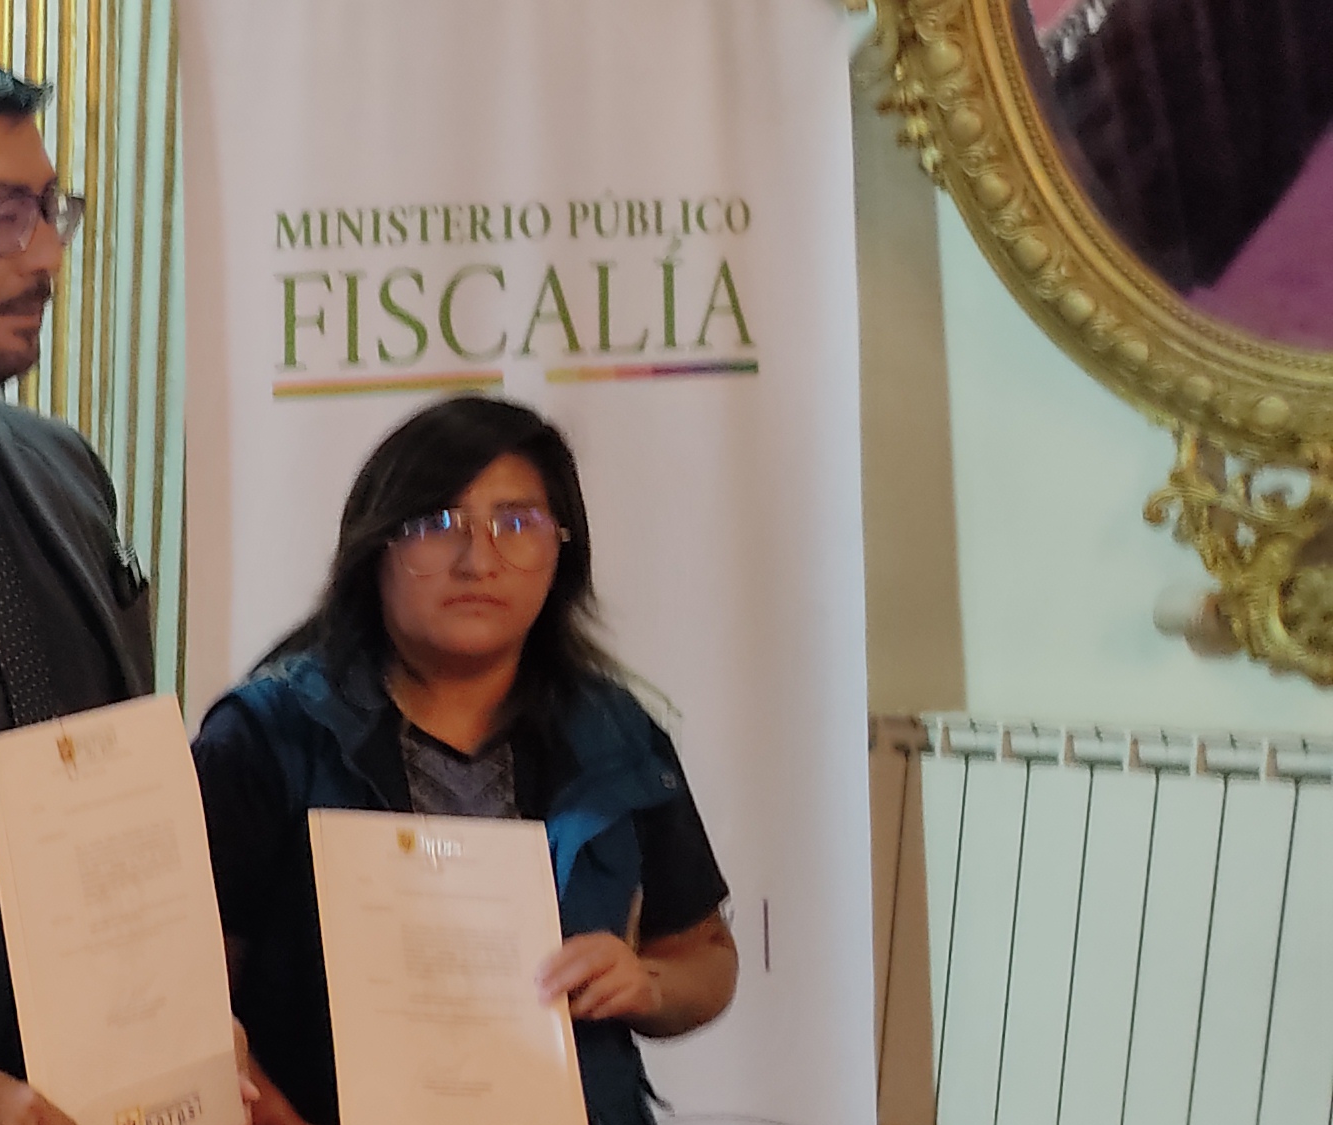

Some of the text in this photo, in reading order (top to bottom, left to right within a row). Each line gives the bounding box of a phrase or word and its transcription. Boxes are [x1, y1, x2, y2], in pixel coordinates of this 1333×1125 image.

[275, 188, 751, 248] MINISTERIO PÚBLICO
[273, 237, 755, 372] FISCALÍA
